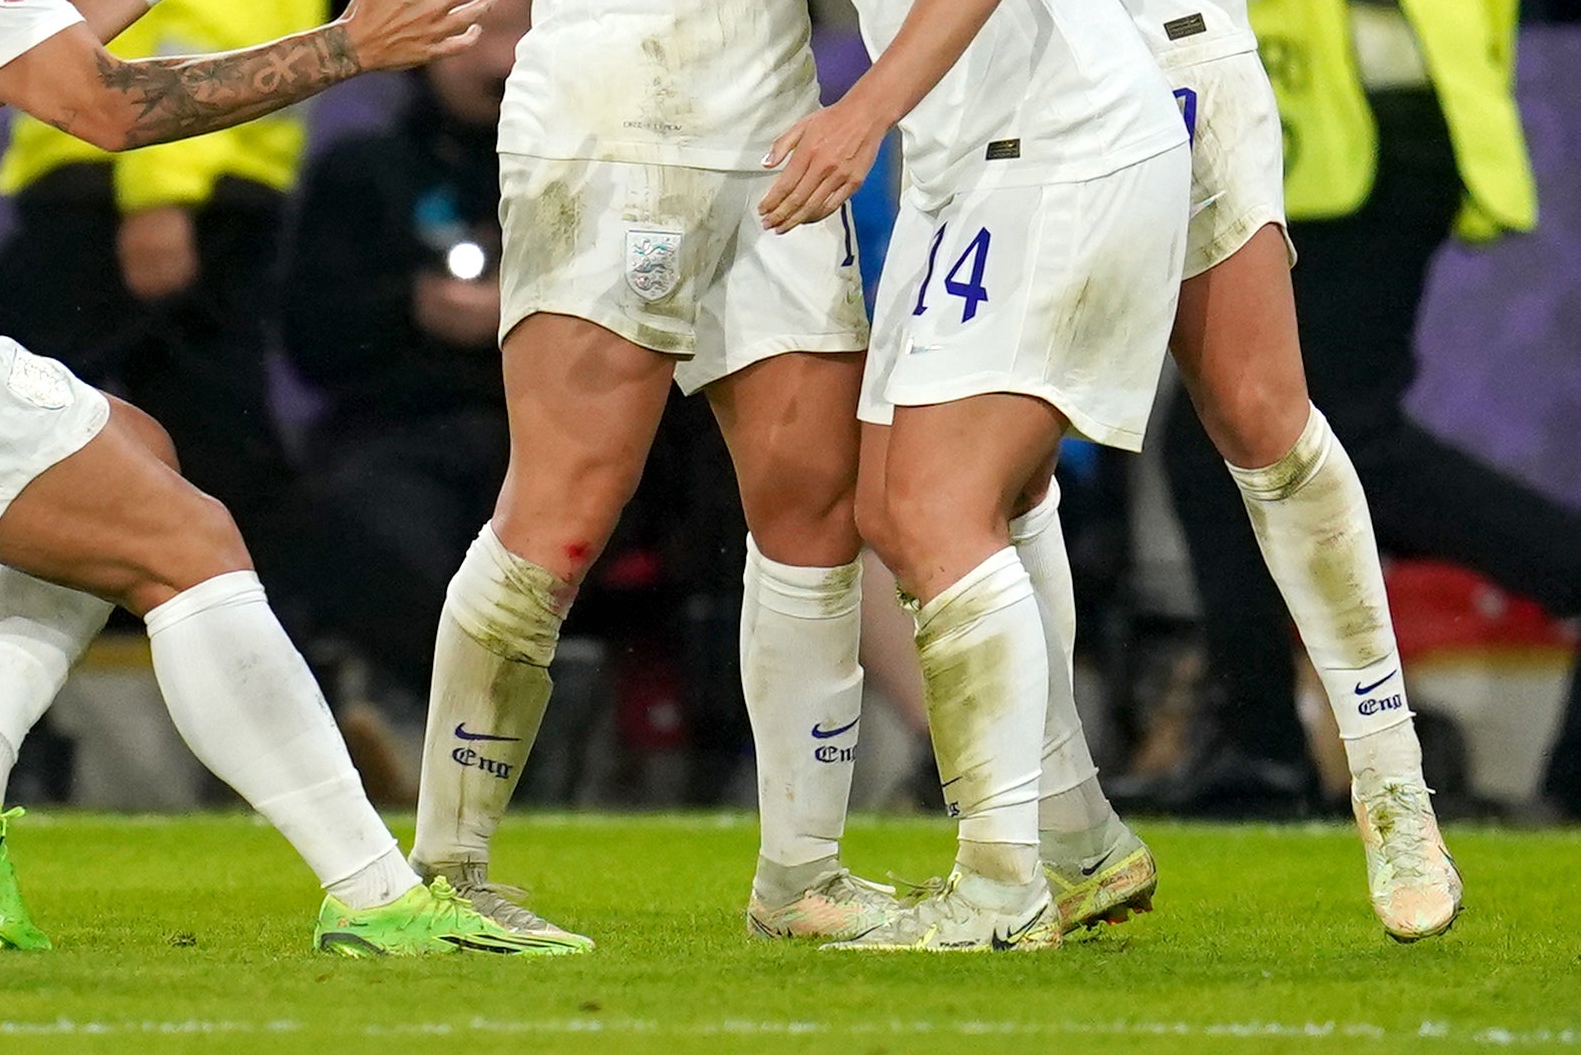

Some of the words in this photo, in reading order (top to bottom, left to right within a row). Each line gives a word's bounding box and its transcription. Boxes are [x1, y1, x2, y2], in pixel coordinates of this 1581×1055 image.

[912, 221, 991, 325] 14
[1358, 694, 1402, 716] Eng
[452, 747, 513, 779] Eng
